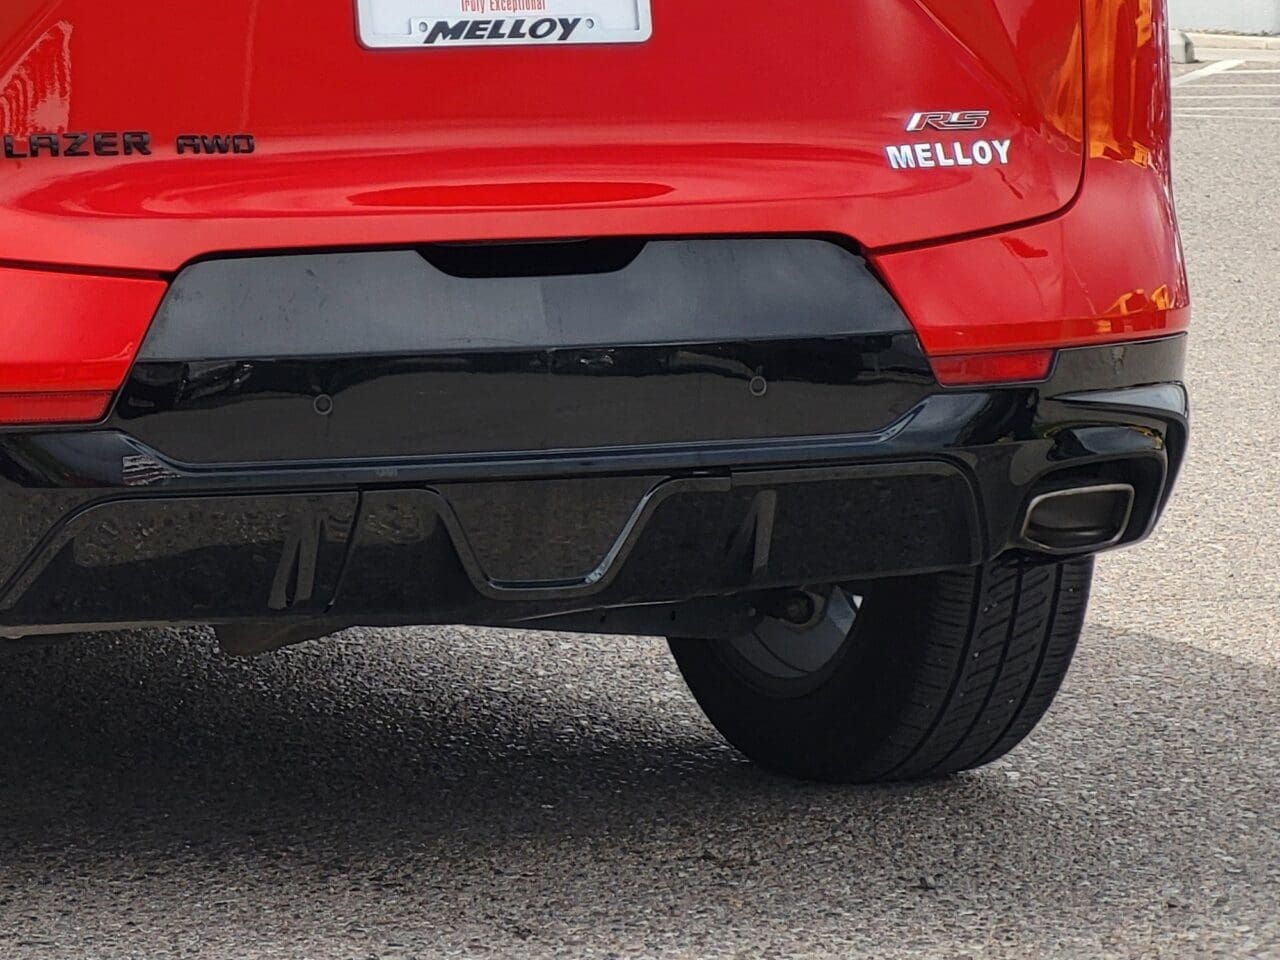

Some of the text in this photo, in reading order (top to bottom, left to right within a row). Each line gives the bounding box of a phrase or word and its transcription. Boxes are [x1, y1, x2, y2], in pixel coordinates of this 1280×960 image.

[423, 17, 582, 44] MELLOY
[905, 110, 990, 132] RS
[176, 134, 255, 155] AWD
[885, 139, 1011, 169] MELLOY
